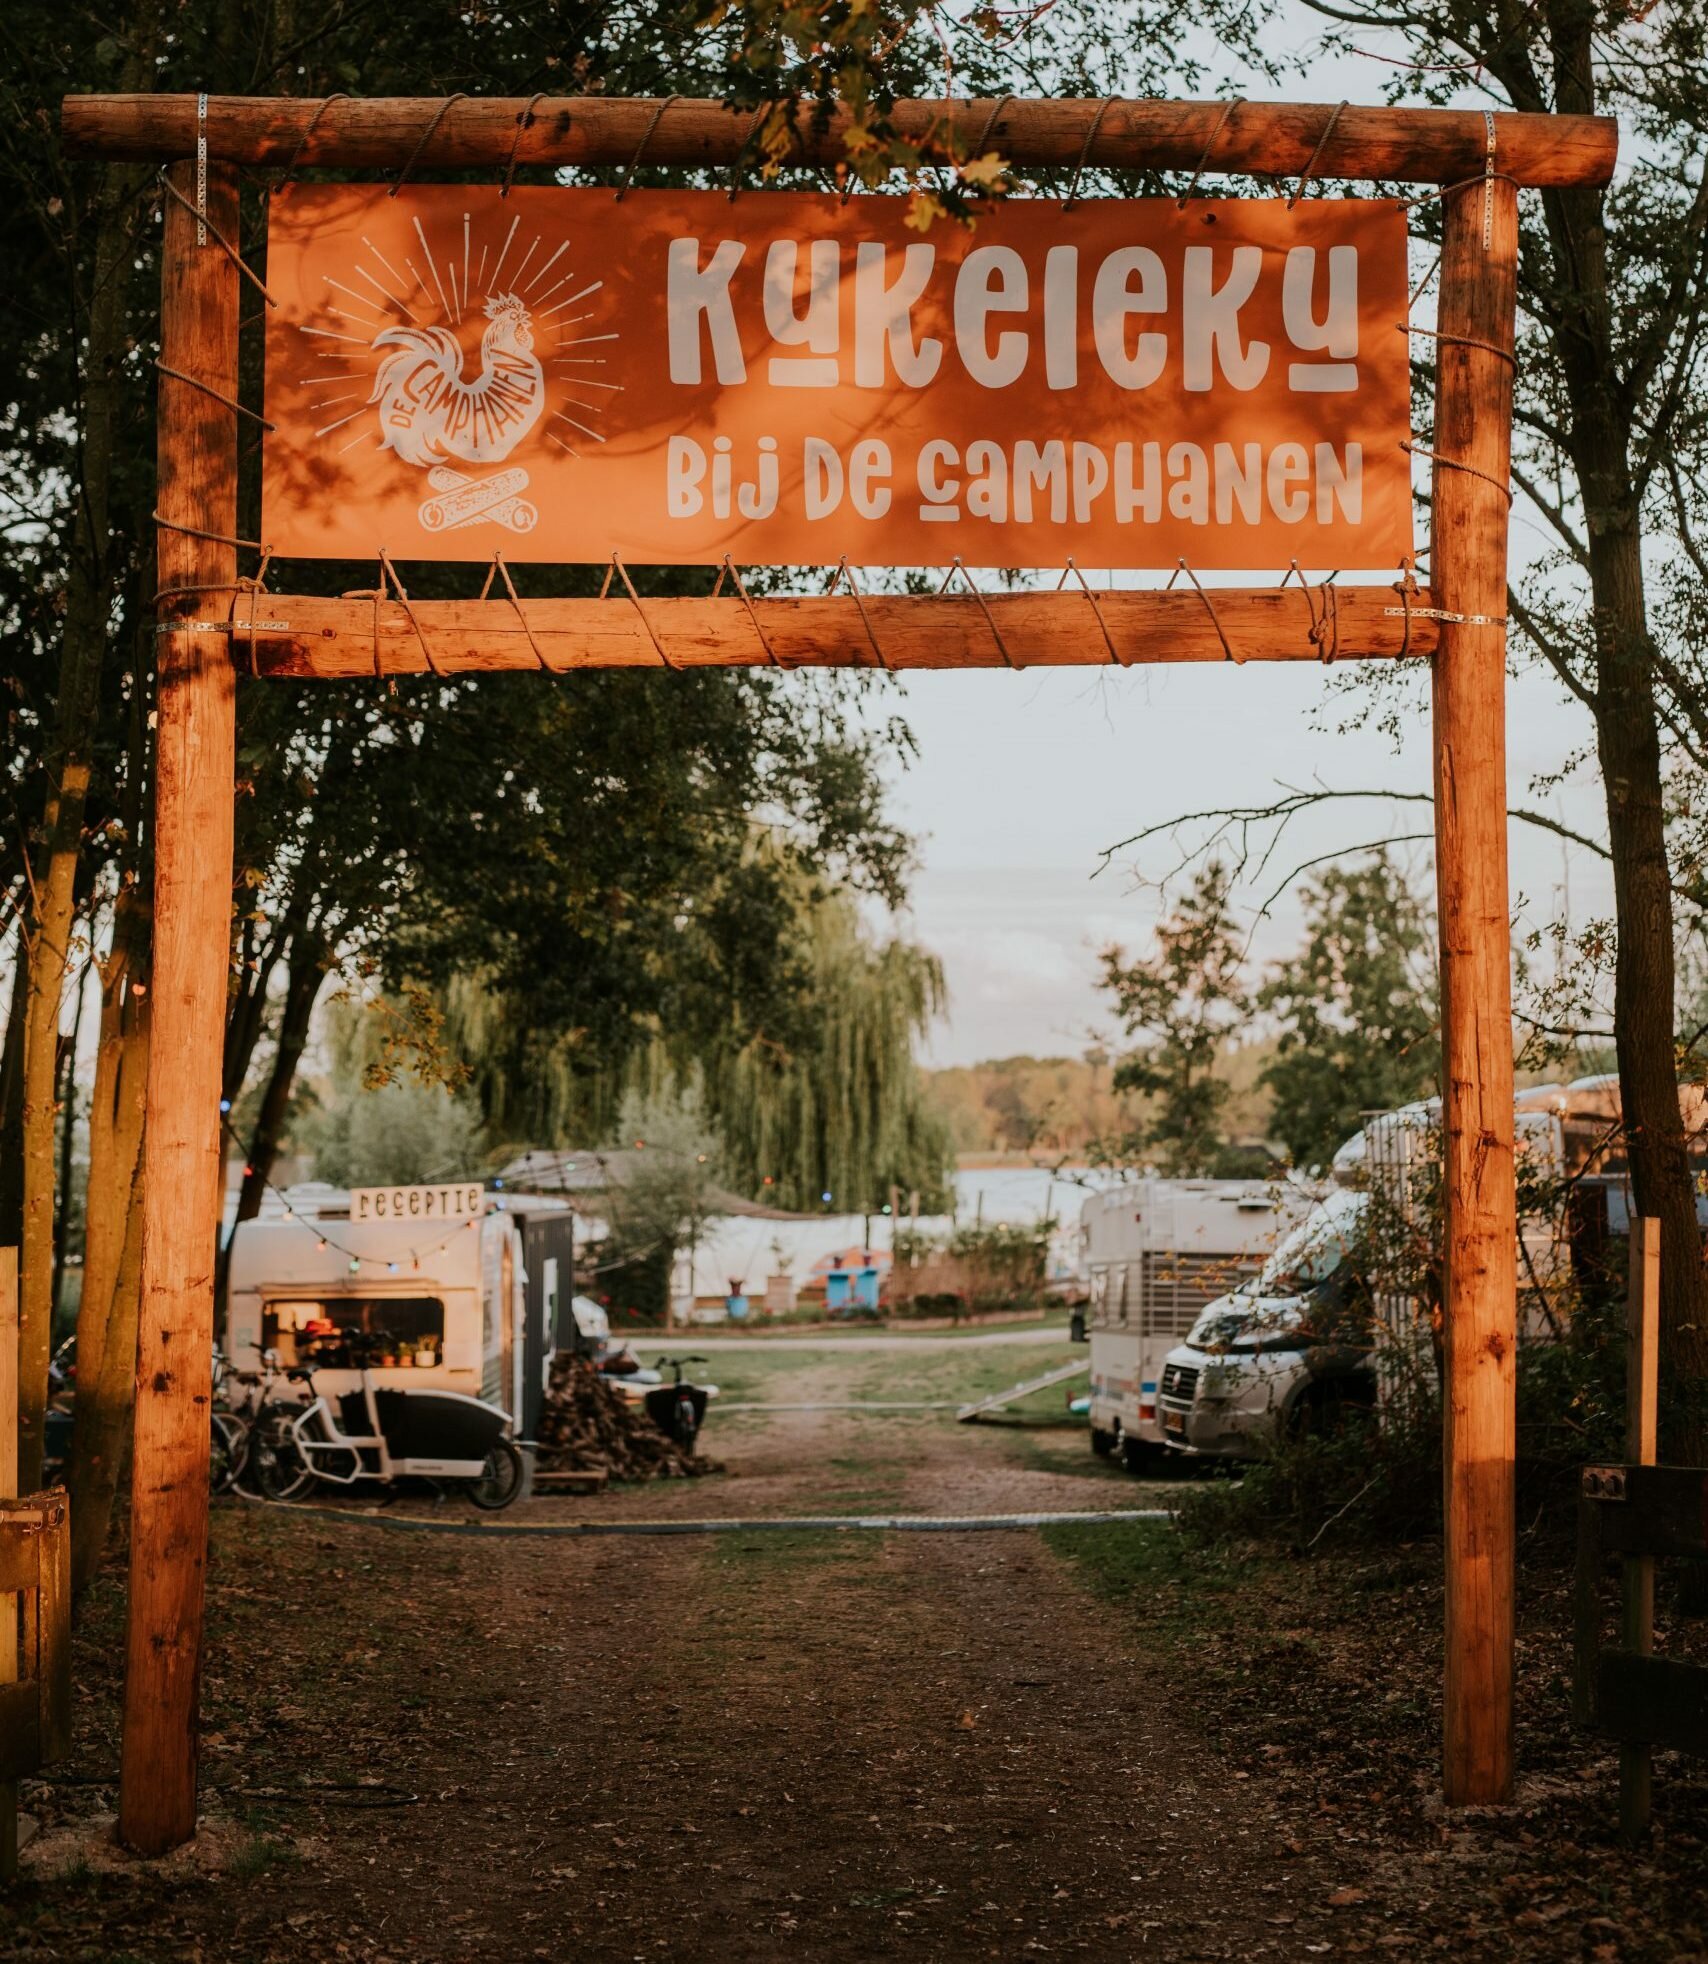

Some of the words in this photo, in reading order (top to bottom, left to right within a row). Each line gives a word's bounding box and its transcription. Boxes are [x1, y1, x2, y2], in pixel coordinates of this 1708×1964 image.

[390, 398, 416, 429] DE
[403, 348, 536, 448] CAMPHANEN
[667, 435, 779, 520] Bij
[804, 436, 892, 521] De
